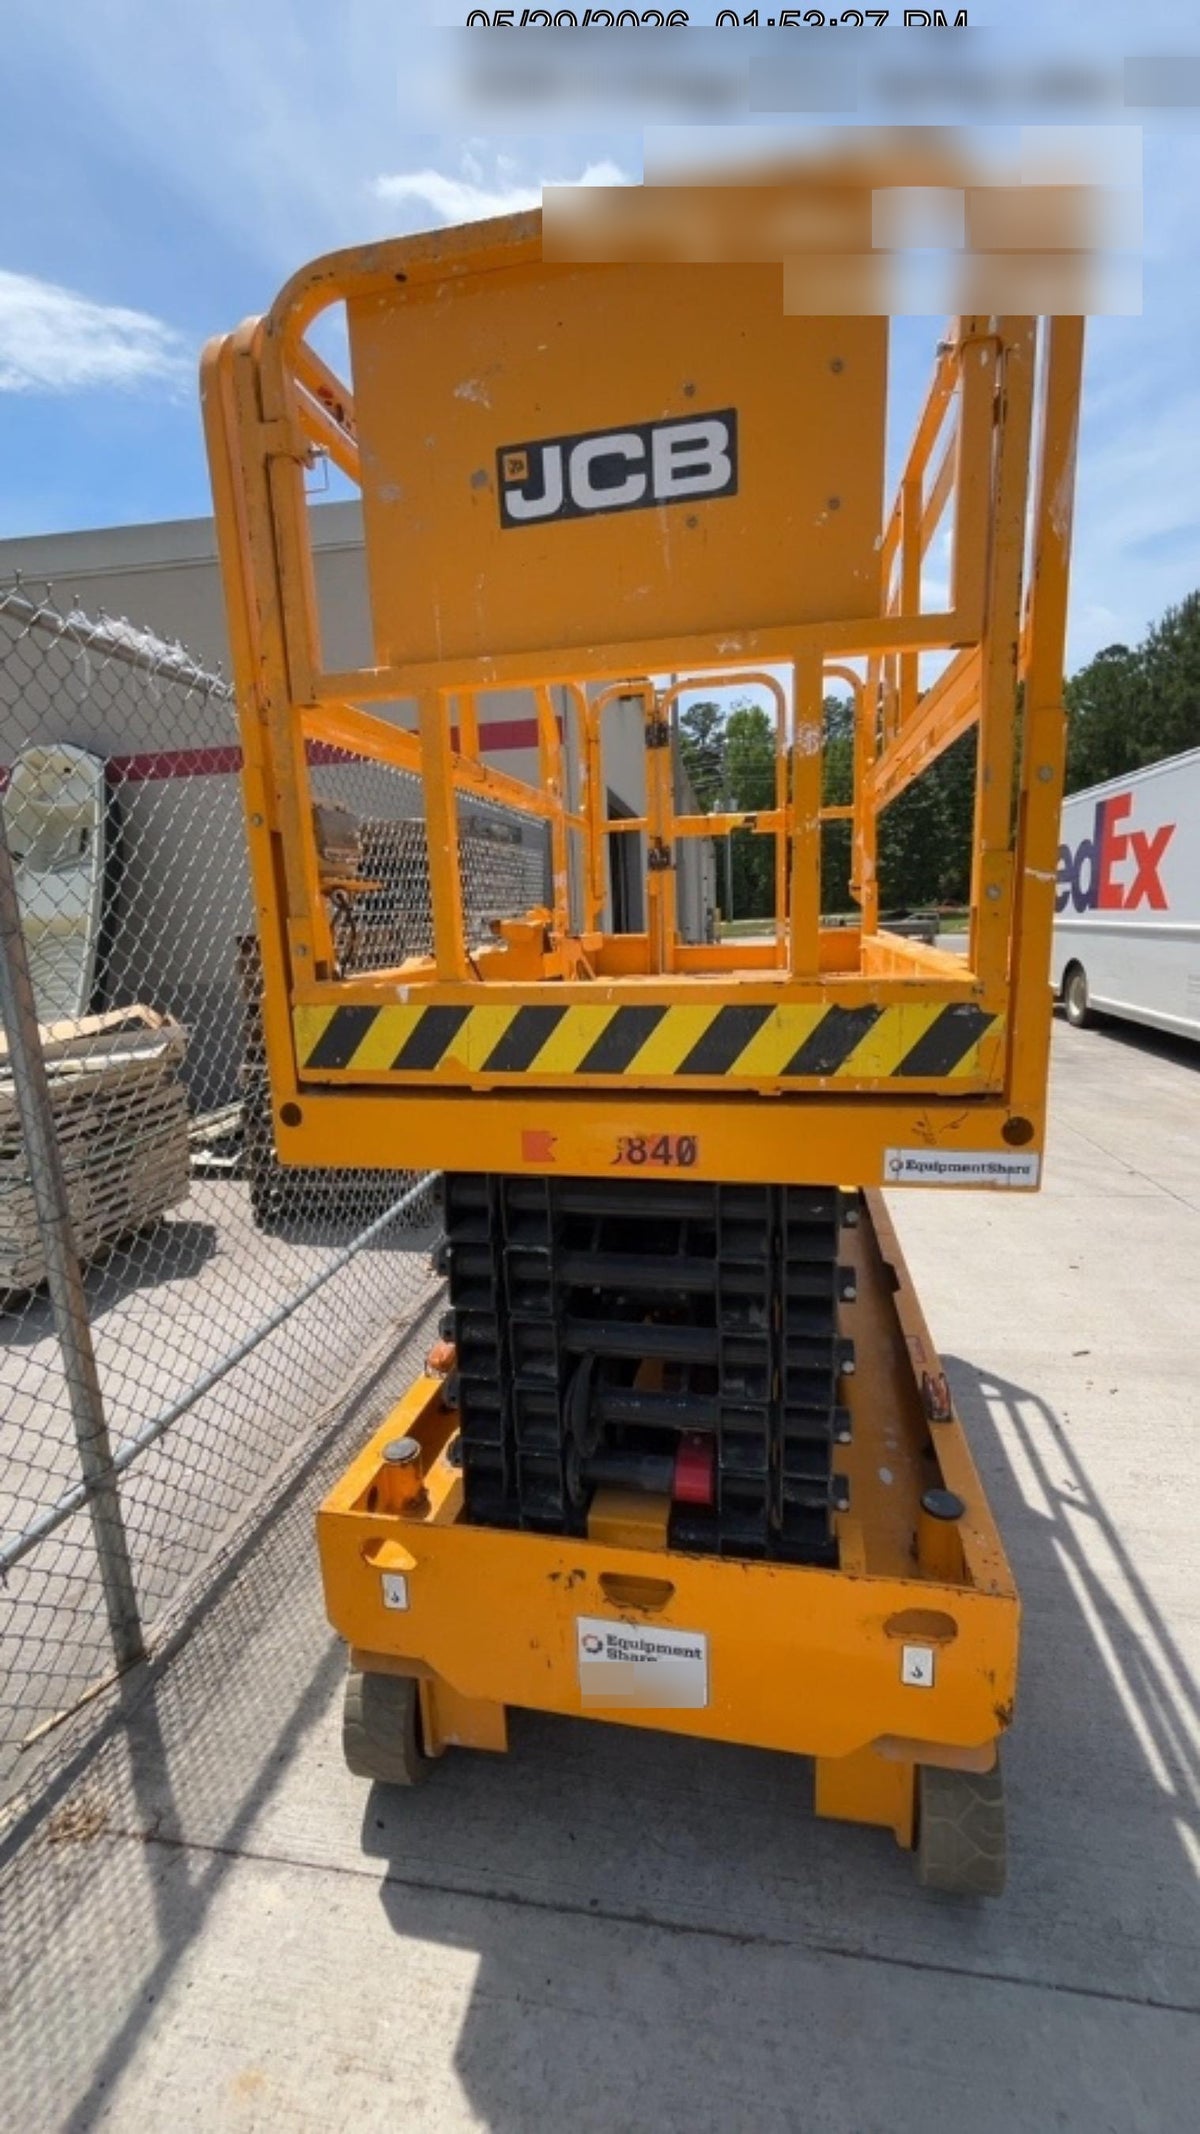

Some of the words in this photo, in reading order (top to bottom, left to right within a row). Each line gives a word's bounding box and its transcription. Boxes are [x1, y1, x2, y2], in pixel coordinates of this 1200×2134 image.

[504, 419, 732, 520] JCB
[1055, 792, 1176, 913] edEx
[905, 1159, 1031, 1175] EquipmentShare
[606, 1633, 703, 1660] Equipment
